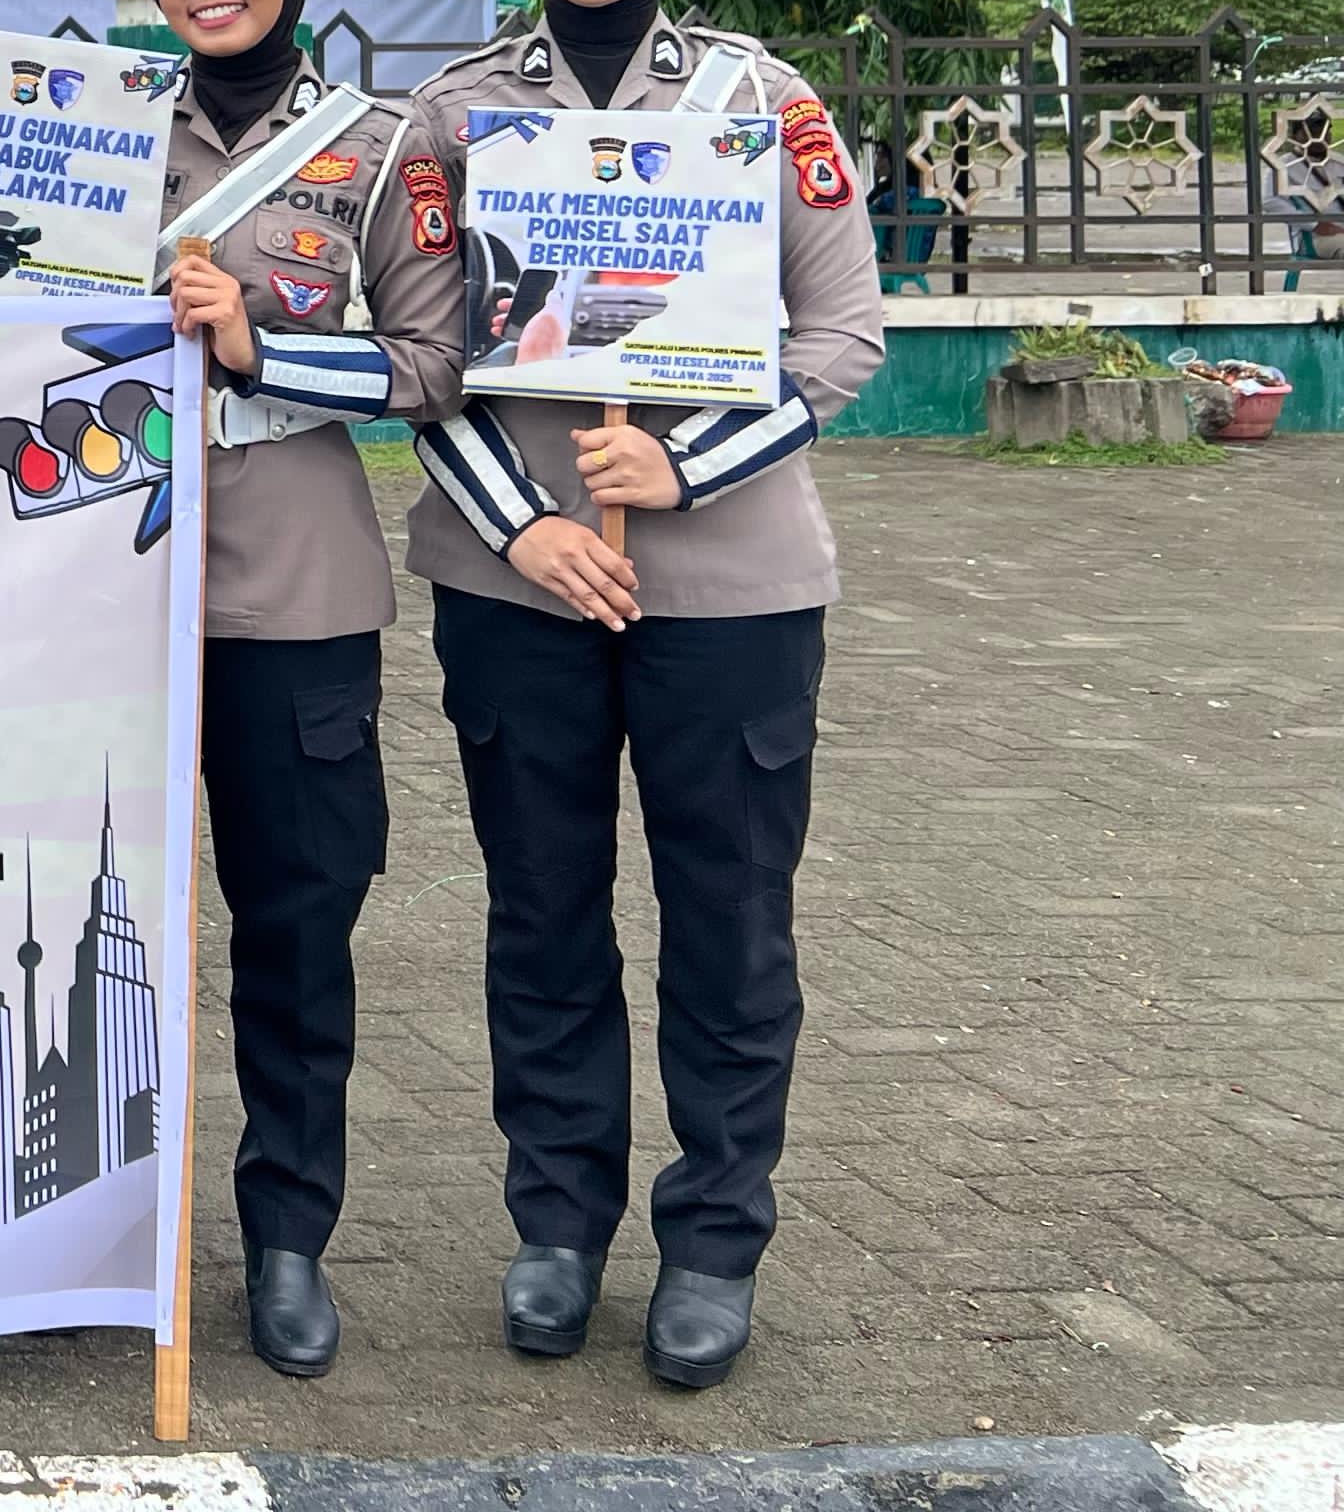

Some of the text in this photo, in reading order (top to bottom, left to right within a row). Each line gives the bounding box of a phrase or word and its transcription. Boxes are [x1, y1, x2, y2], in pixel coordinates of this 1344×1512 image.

[19, 118, 154, 160] GUNAKAN
[265, 188, 358, 225] POLRI
[477, 190, 765, 224] TIDAK MENGGUNAKAN
[527, 217, 710, 247] PONSEL SAAT
[528, 243, 705, 273] BERKENDARA
[16, 269, 62, 285] OPERASI
[620, 353, 766, 371] OPERASI KESELAMATAN
[651, 368, 704, 381] PALLAWA
